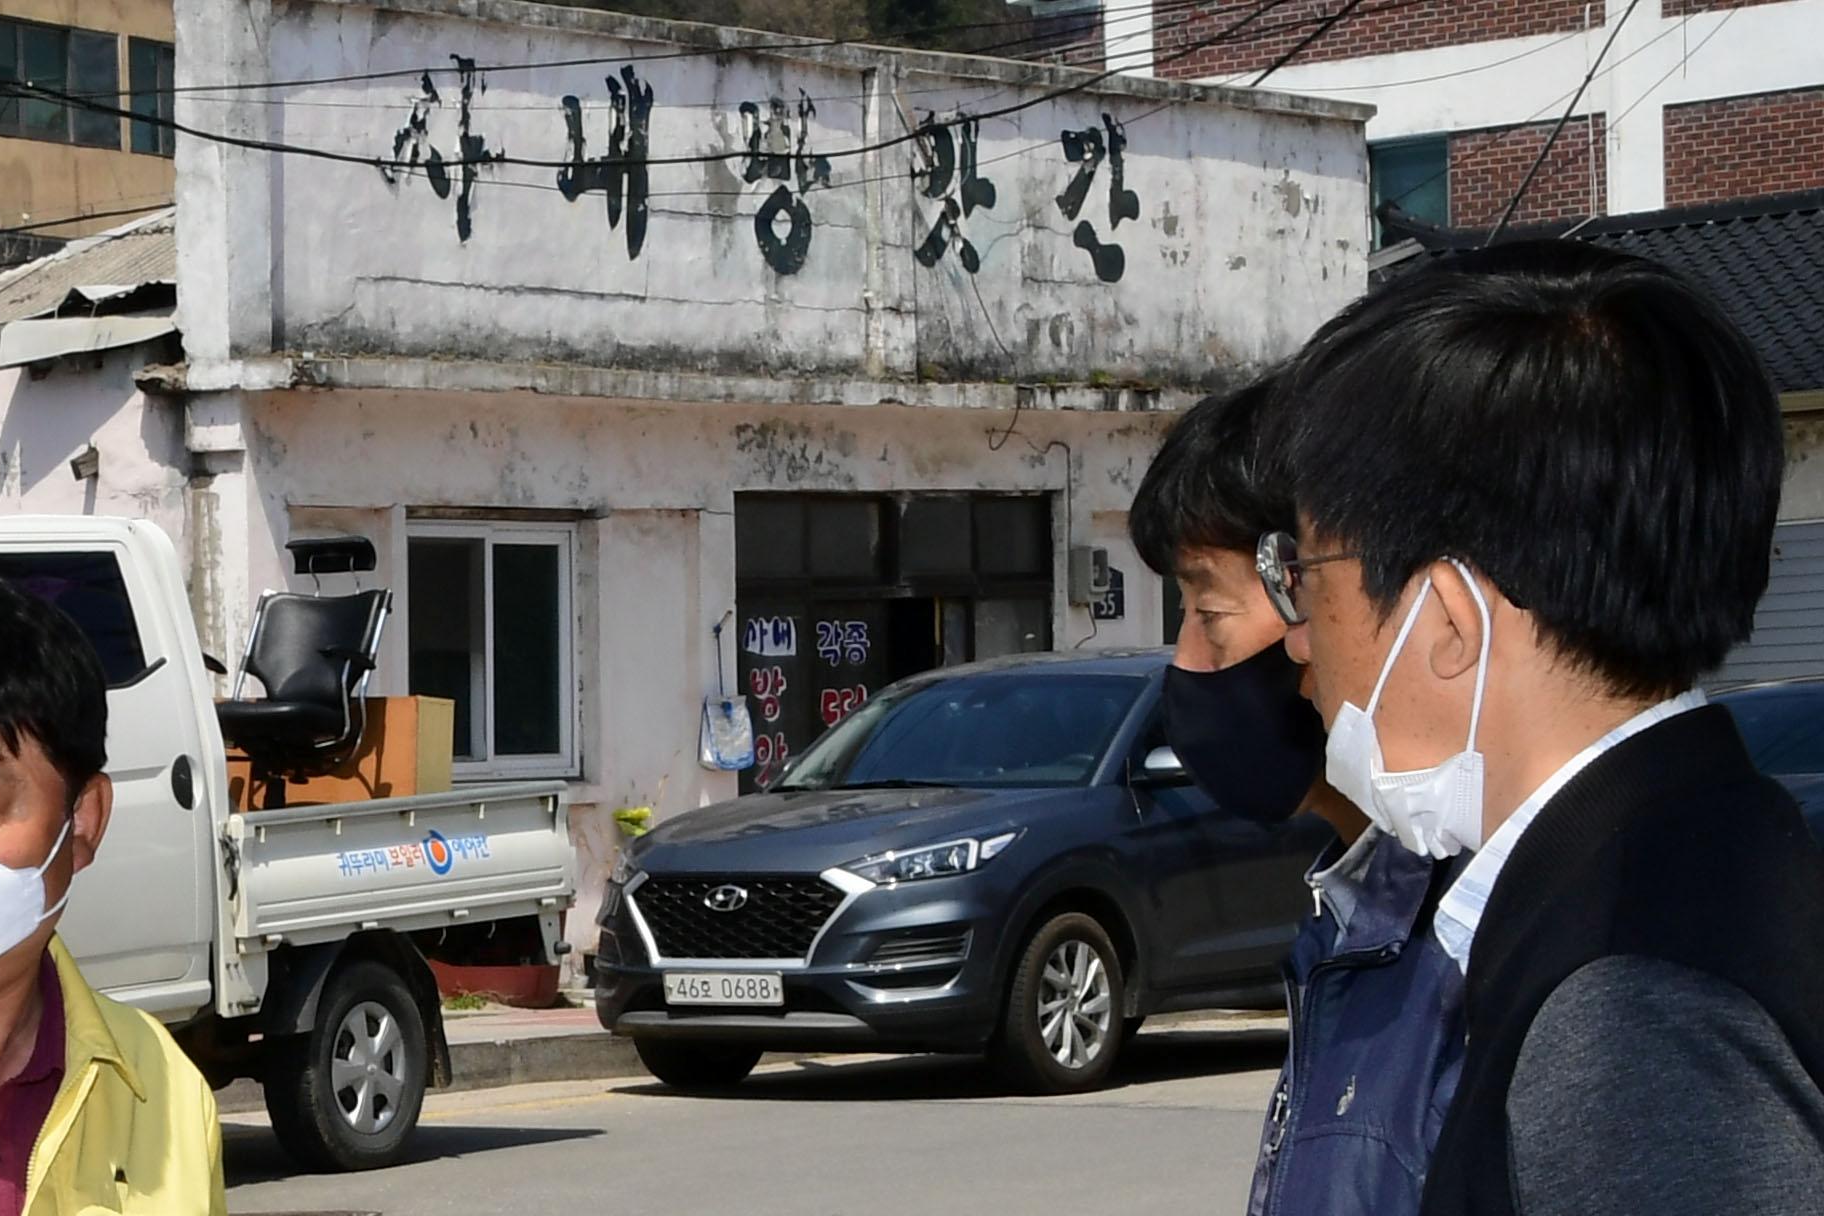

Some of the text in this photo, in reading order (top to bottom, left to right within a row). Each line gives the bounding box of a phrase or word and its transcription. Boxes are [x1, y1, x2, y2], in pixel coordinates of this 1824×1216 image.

[816, 620, 871, 667] 각종
[451, 836, 490, 860] 에어컨
[677, 977, 771, 999] 46호 0688
